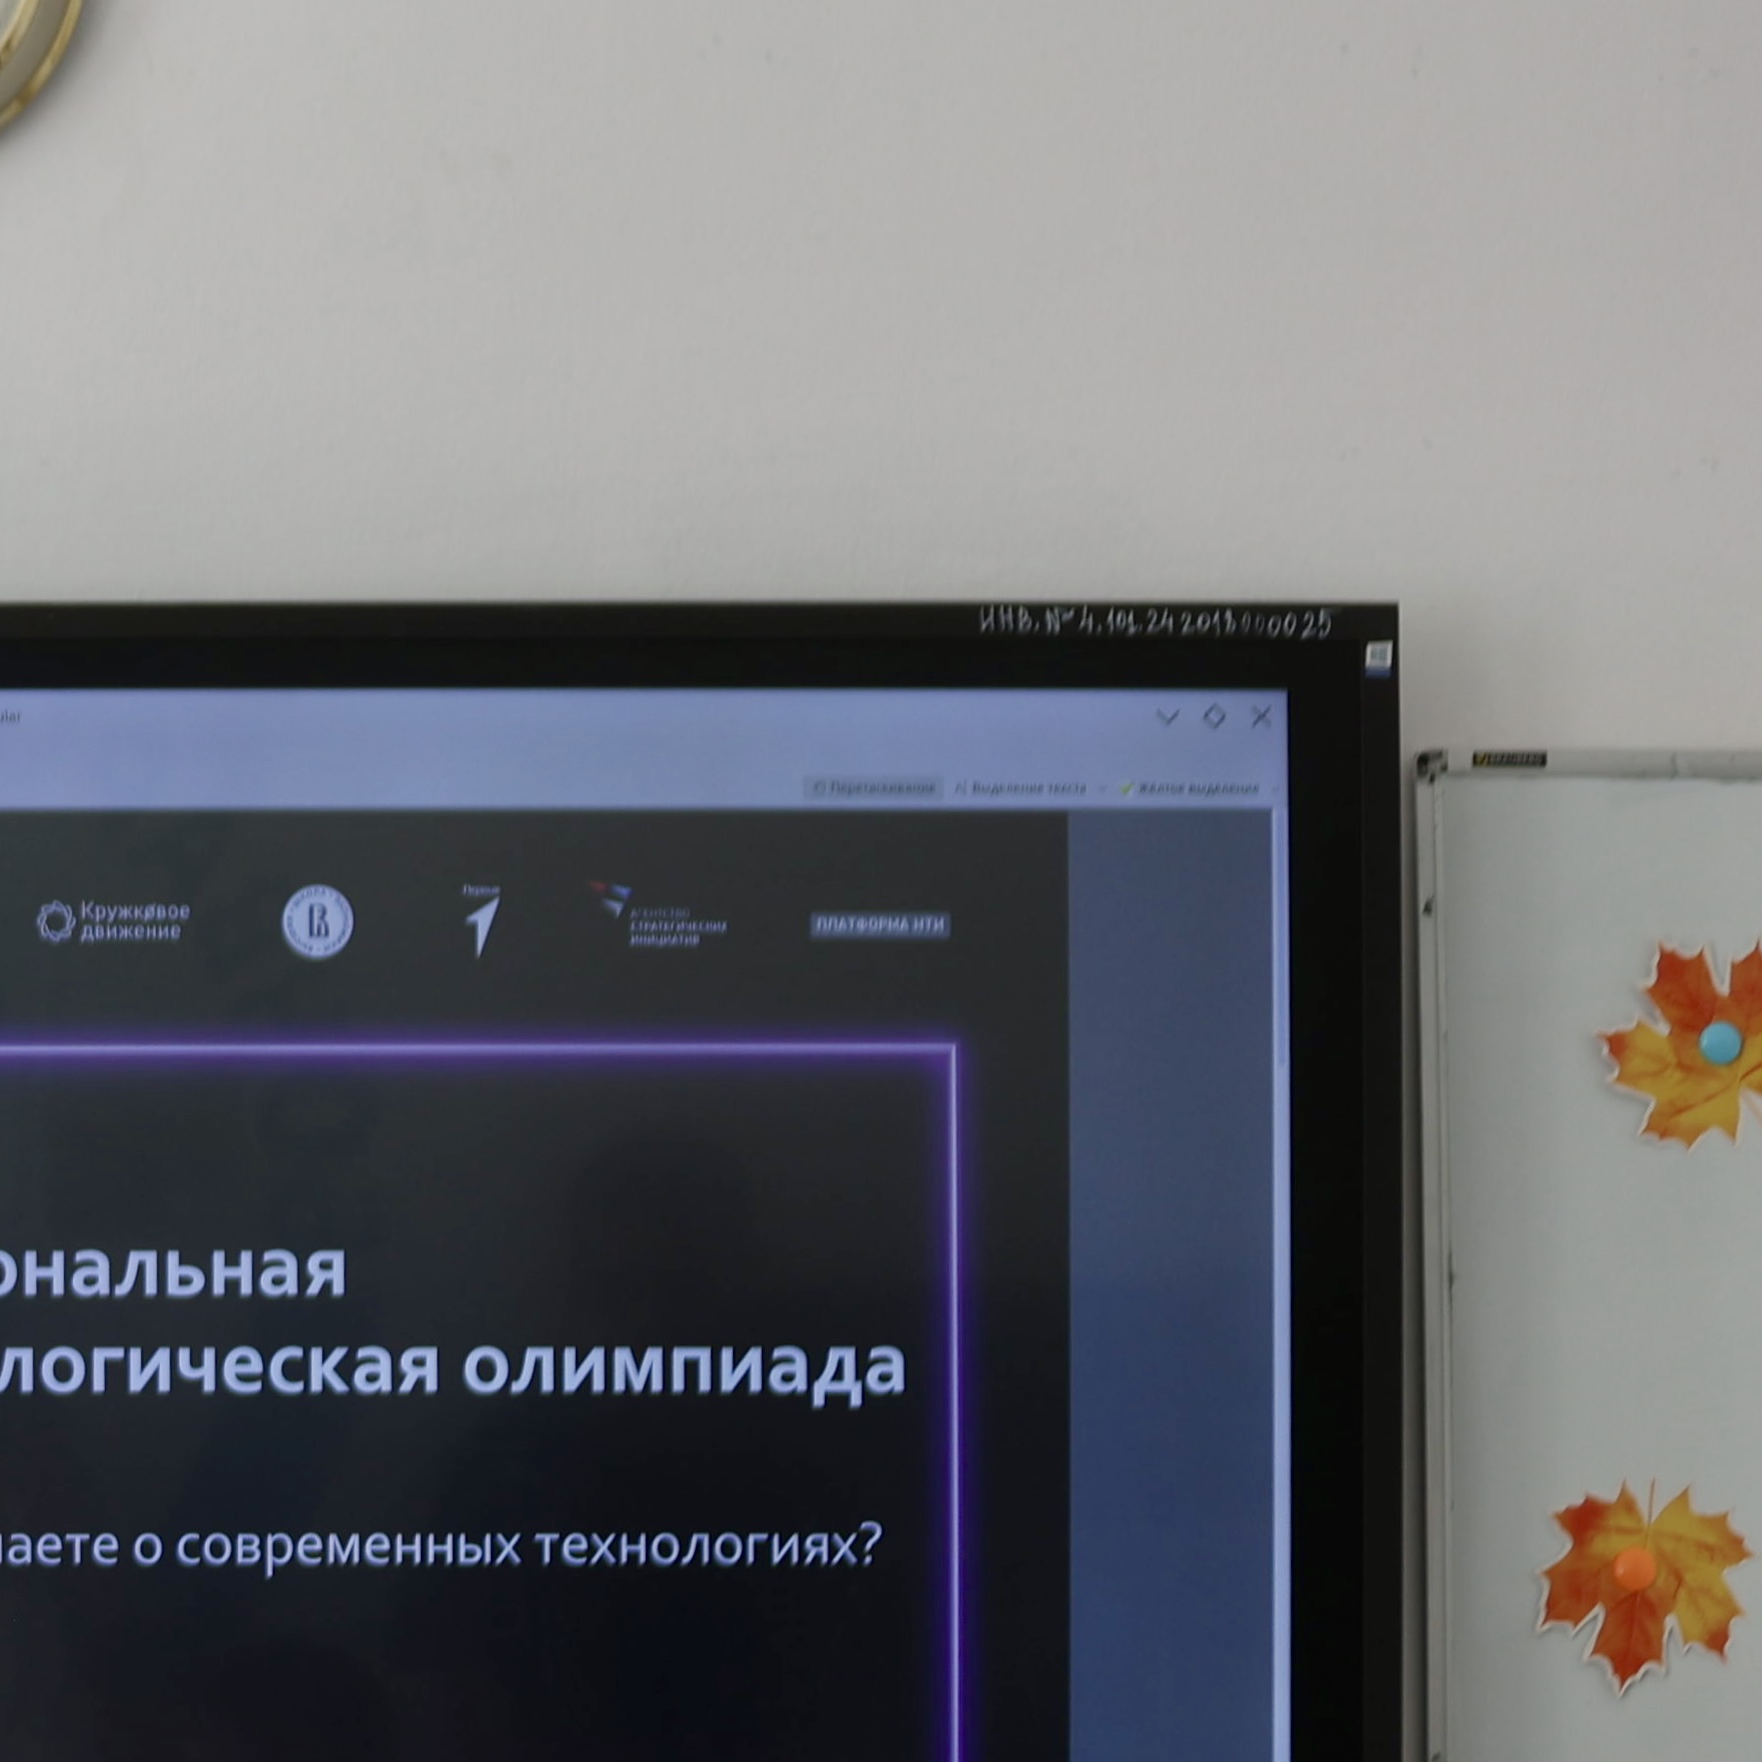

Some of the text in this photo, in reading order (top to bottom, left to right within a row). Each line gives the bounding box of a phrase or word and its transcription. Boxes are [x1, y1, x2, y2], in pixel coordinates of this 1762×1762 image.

[80, 924, 182, 943] движение
[816, 915, 945, 933] ПЛАТФОРМА НТИ
[462, 1343, 907, 1409] олимпиада
[133, 1532, 164, 1567] о
[176, 1531, 522, 1579] современных
[534, 1520, 883, 1567] технологиях?
